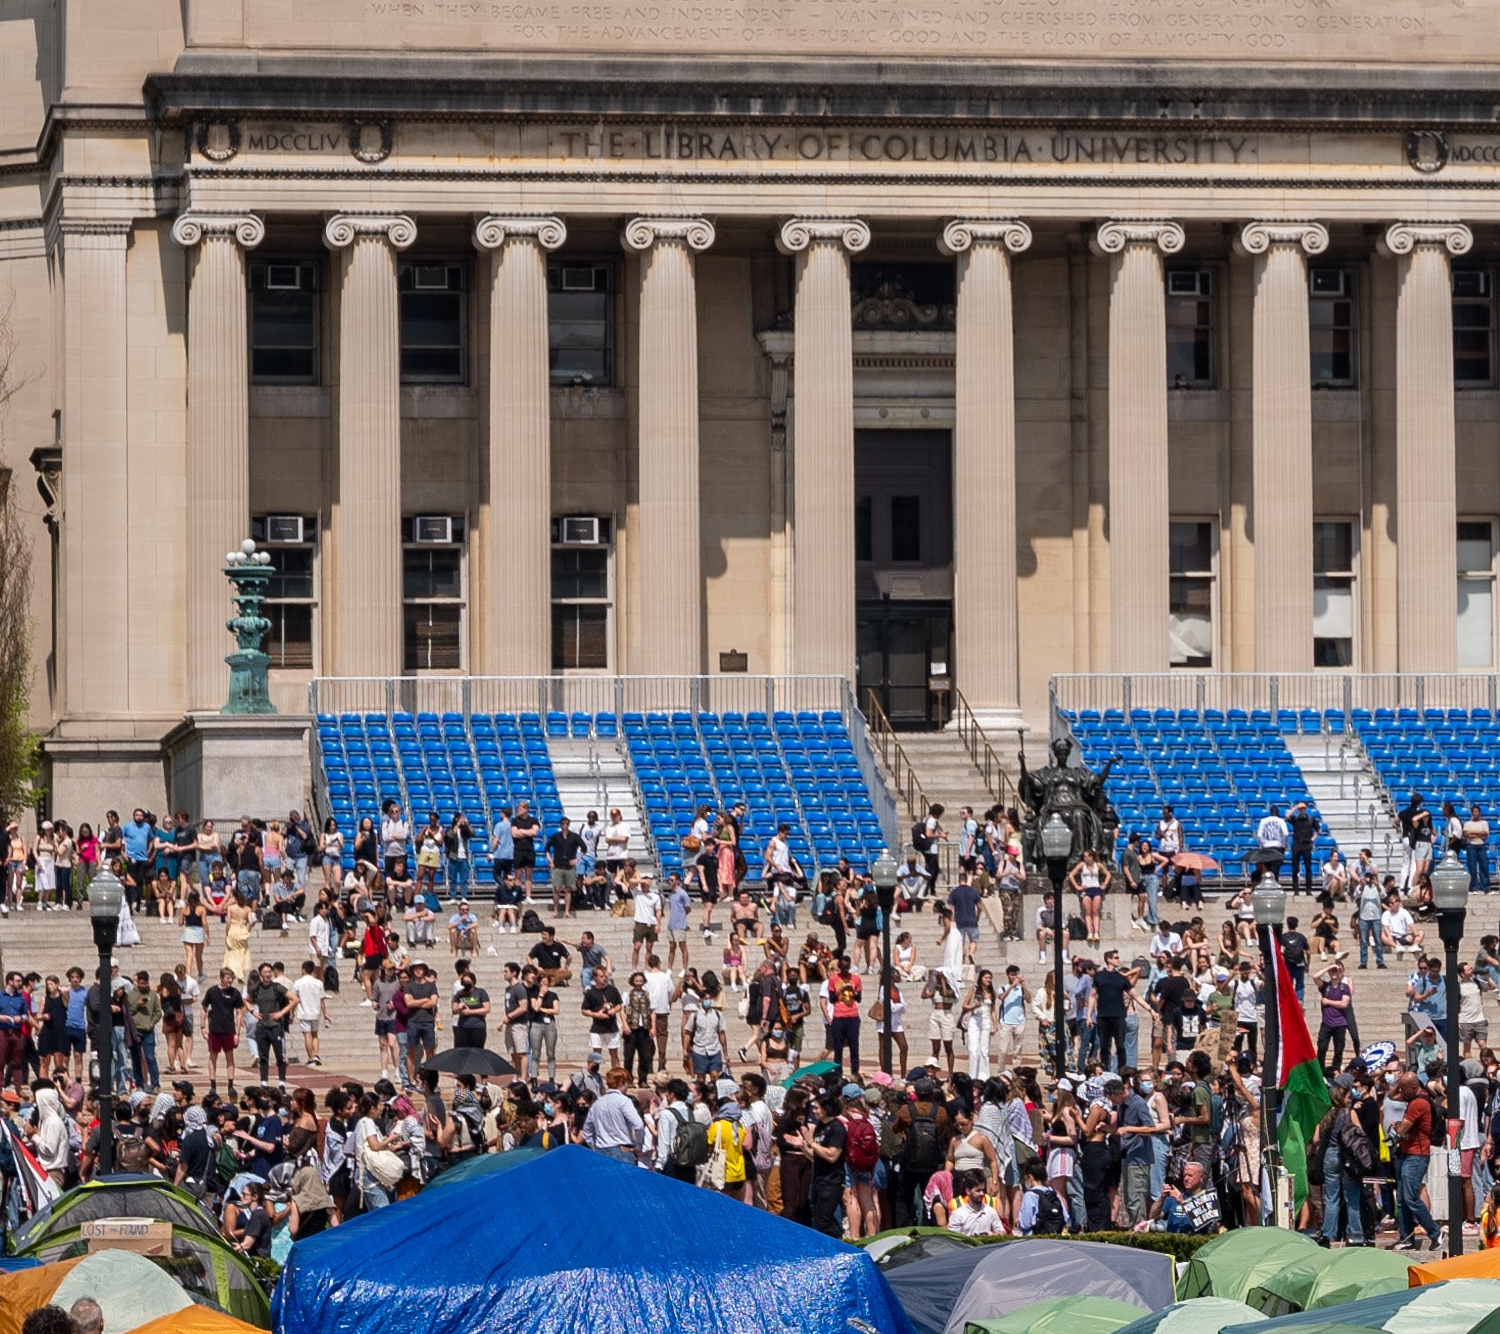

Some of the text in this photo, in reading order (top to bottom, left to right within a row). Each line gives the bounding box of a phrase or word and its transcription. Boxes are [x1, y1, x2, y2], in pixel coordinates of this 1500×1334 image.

[372, 3, 1424, 29] WHEN THEY BECAME FREE AND INDEPENDENT MAINTAINED AND CHERISHED FROM GENERATION TO GENERATION
[513, 25, 1286, 47] FOR THE ADVANCEMENT OF THE PUBLIC GOOD AND THE GLORY OF ALMIGHTY GOD
[248, 133, 341, 151] MDCCLIV
[560, 132, 1248, 163] THE LIBRARY OF COLUMBIA UNIVERSITY
[81, 1224, 107, 1236] LOST
